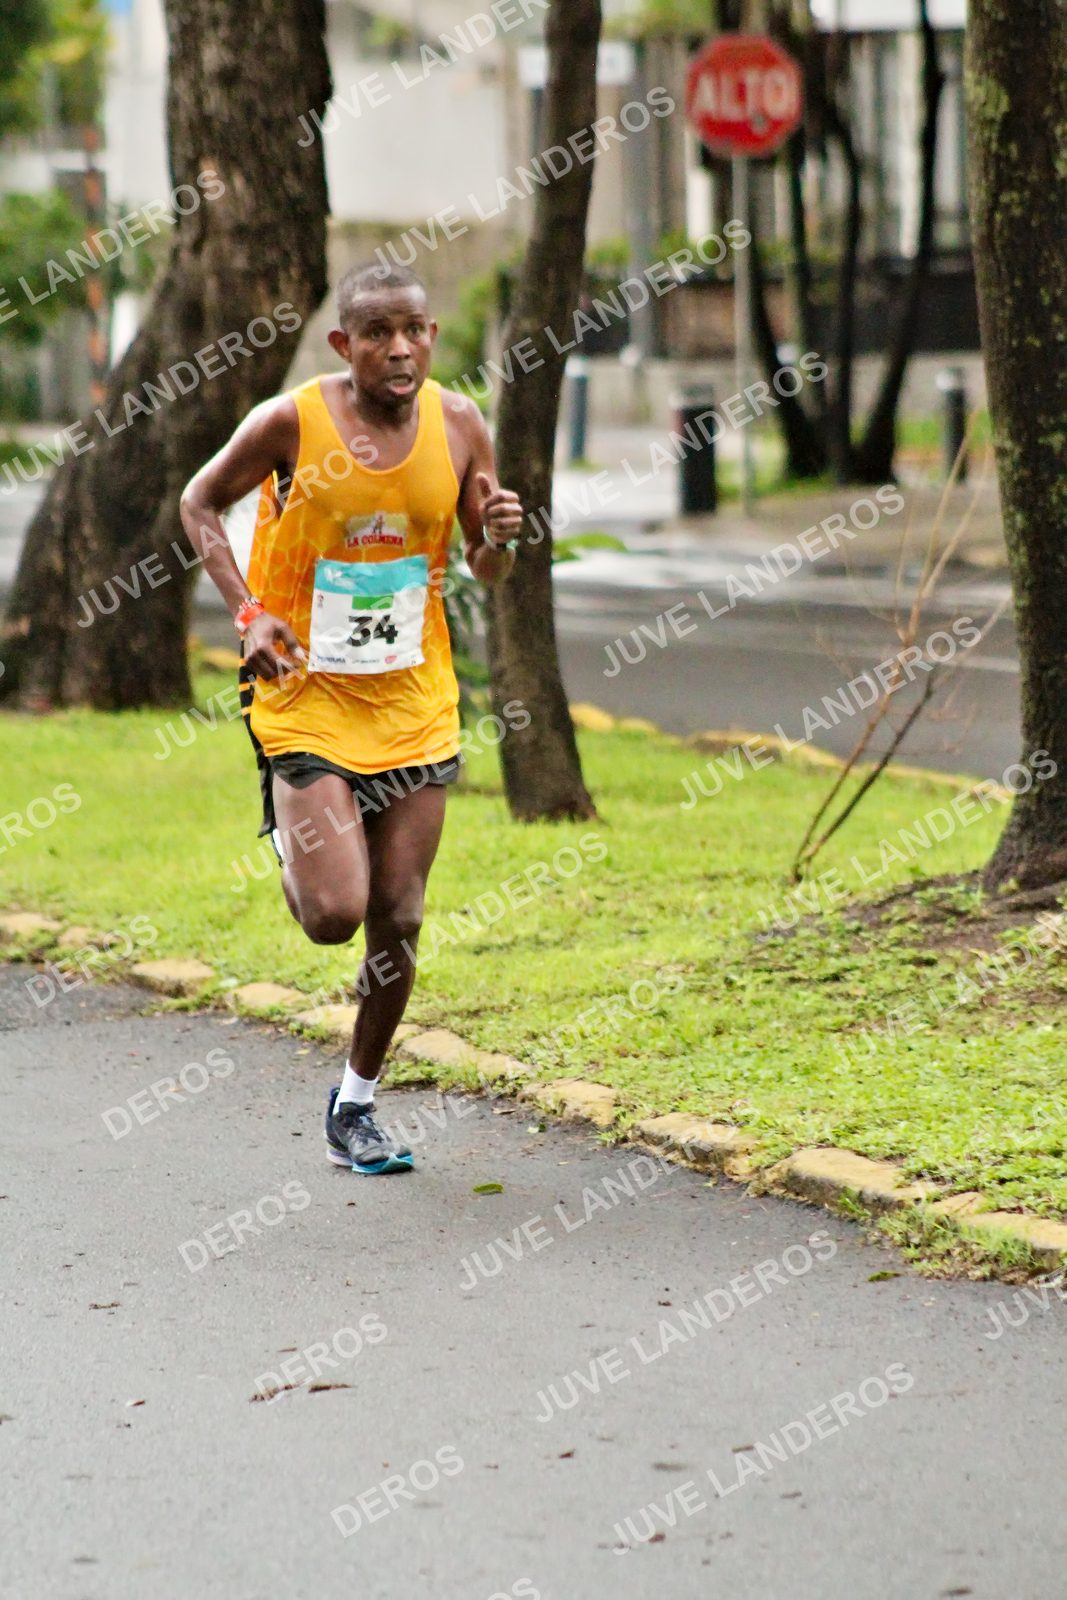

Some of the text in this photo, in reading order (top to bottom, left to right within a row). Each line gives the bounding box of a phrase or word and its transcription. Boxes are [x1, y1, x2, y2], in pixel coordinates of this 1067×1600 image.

[695, 67, 792, 122] ALTO
[347, 536, 359, 548] LA
[347, 614, 398, 647] 34
